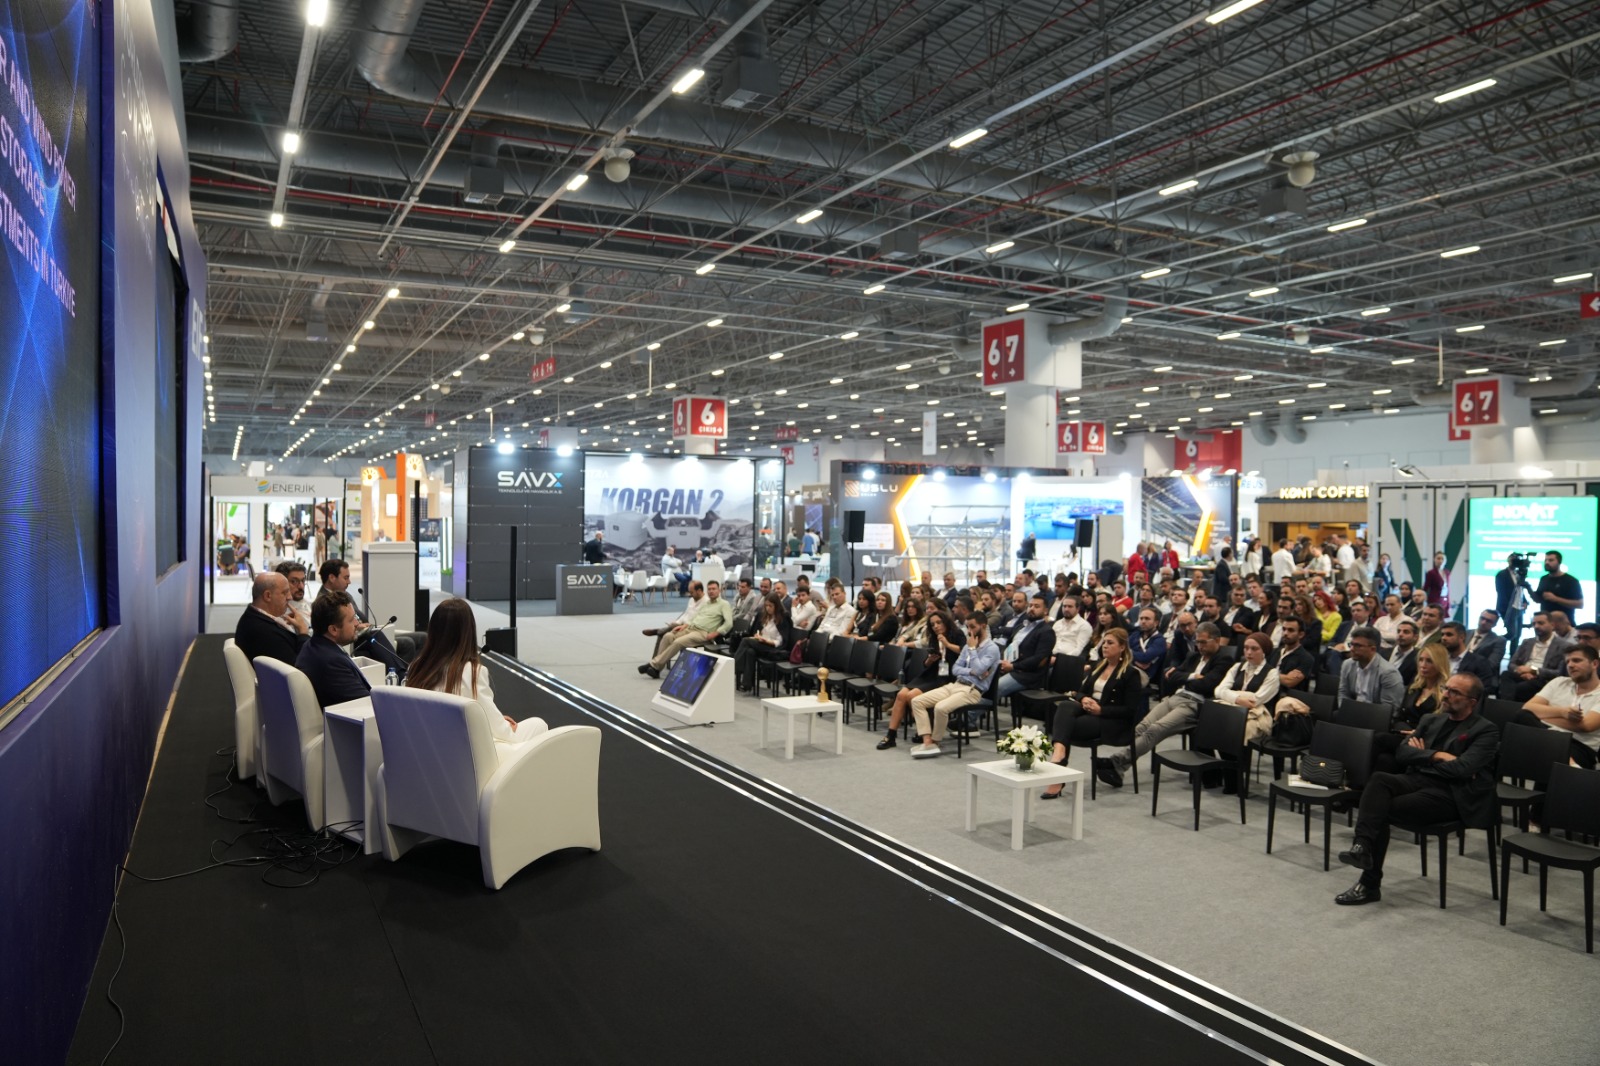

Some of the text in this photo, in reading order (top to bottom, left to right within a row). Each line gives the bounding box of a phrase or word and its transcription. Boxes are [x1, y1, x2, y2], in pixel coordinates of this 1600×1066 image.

[10, 60, 30, 124] AND
[32, 98, 52, 165] WIND
[54, 143, 76, 212] POWER
[1, 115, 45, 218] STORAGE
[41, 246, 49, 286] IN
[988, 334, 1019, 366] 6 7
[1460, 390, 1494, 413] 6 7
[677, 403, 683, 426] 6
[701, 402, 716, 426] 6
[1063, 425, 1073, 445] 6
[1088, 425, 1099, 445] 6
[1186, 440, 1197, 458] 6
[272, 482, 316, 493] ENERJİK
[497, 470, 564, 488] SAVX
[860, 483, 899, 493] USLU
[600, 487, 725, 515] KORGAN 2
[566, 574, 608, 585] SAVX
